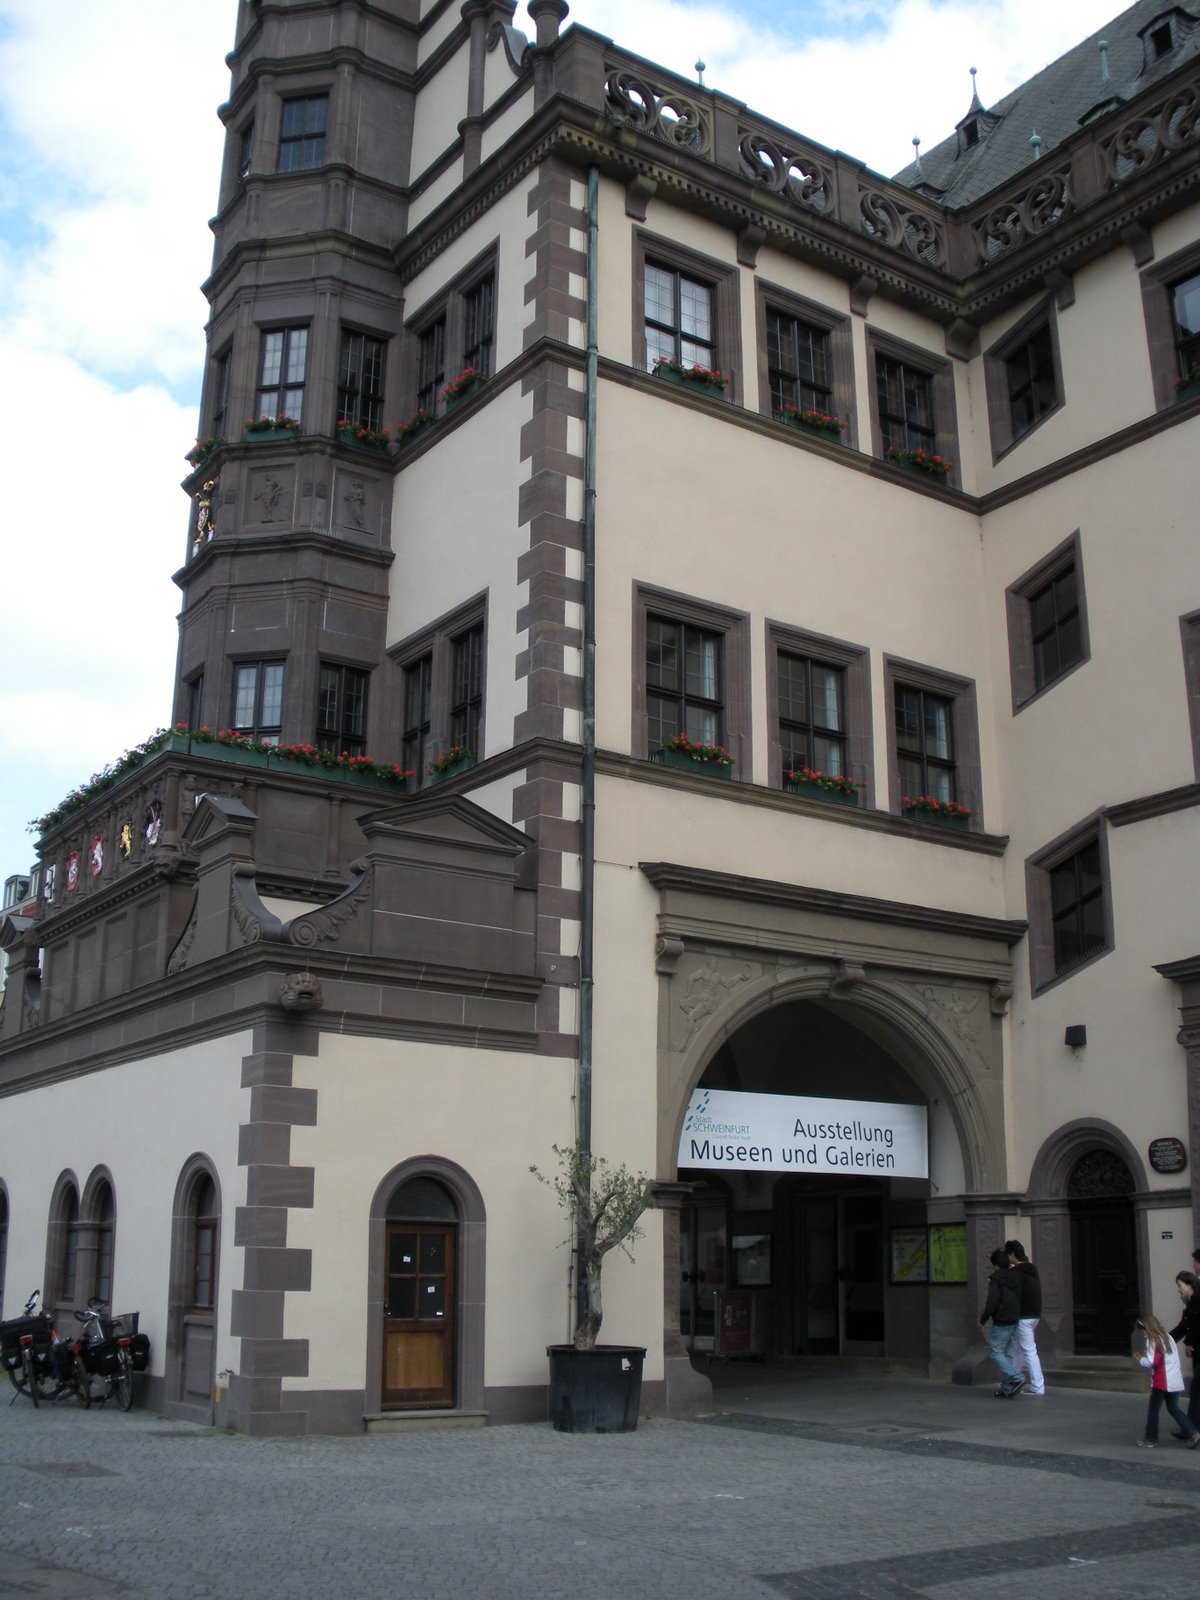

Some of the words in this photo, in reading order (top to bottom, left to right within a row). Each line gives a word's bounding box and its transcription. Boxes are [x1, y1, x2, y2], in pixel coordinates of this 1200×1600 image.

[692, 1123, 752, 1135] SCHWEINFURT
[695, 1115, 713, 1124] Stadt
[793, 1118, 894, 1148] Ausstellung
[691, 1139, 773, 1163] Museen
[782, 1143, 818, 1165] und
[825, 1146, 895, 1169] Galerien
